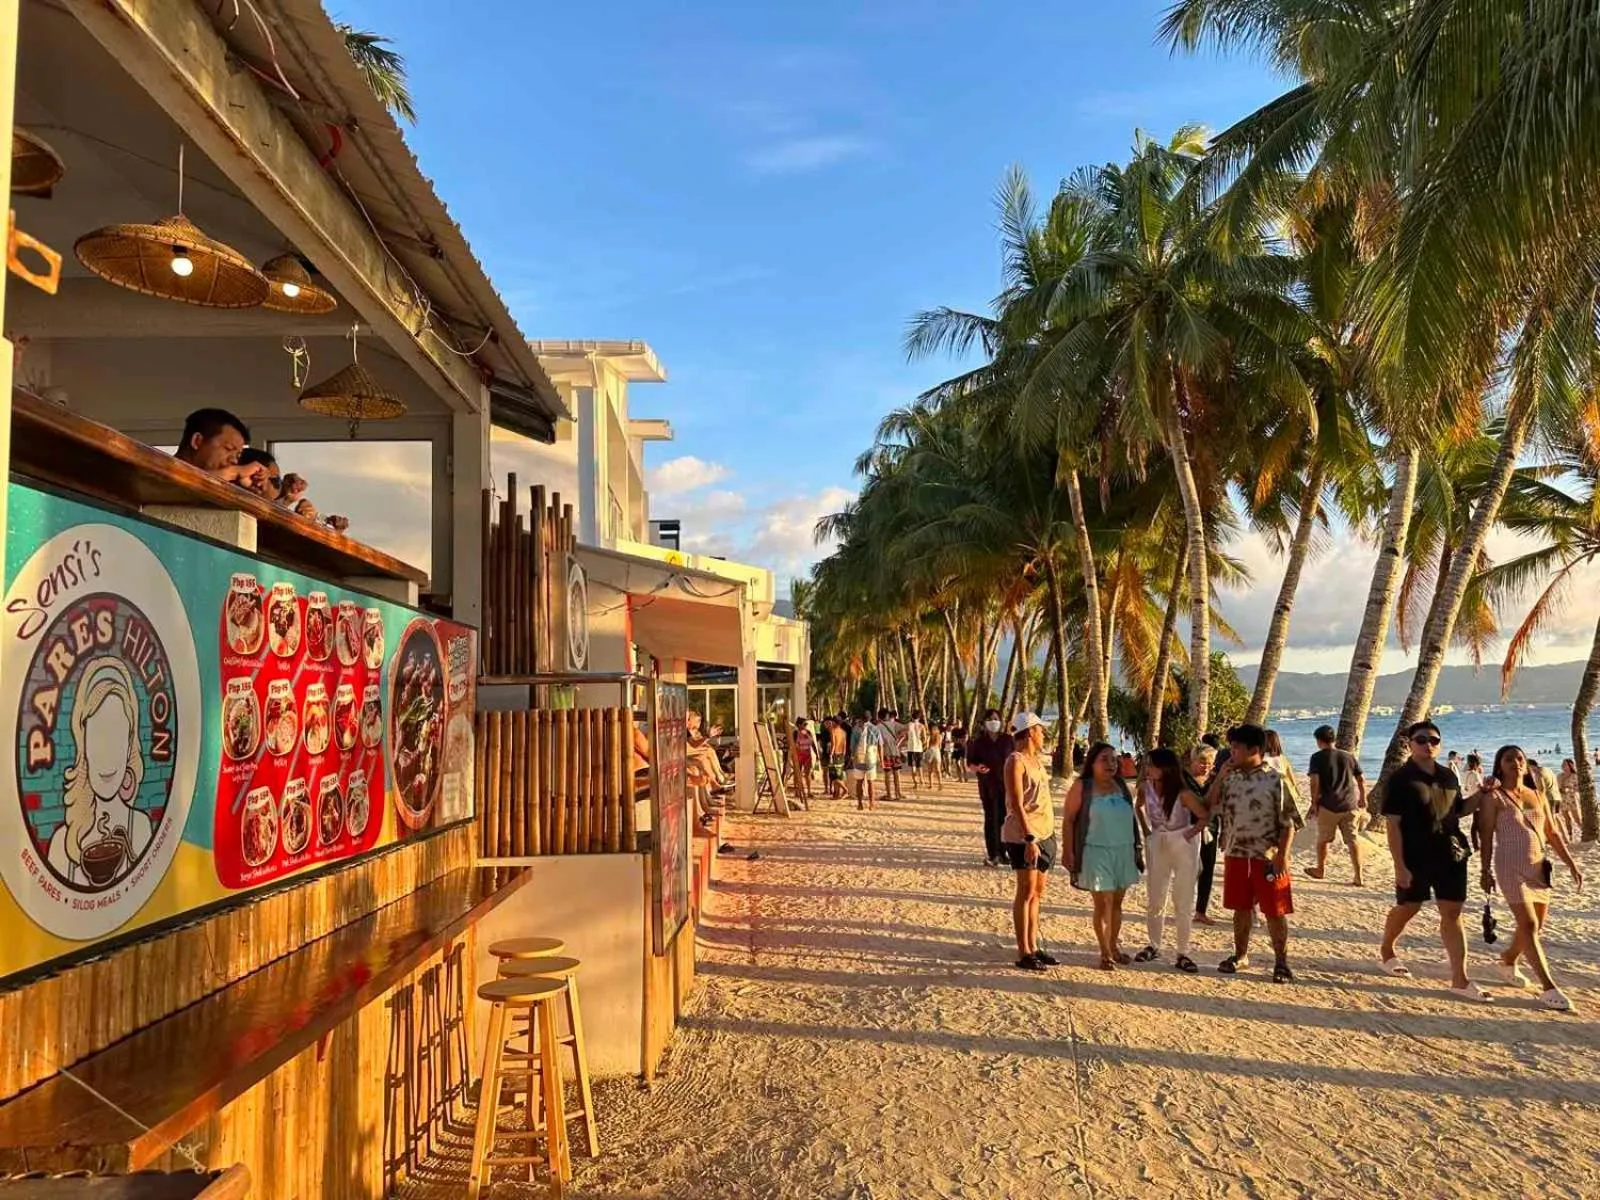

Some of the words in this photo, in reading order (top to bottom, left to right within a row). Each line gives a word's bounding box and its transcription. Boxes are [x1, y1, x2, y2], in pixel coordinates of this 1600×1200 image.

[6, 540, 101, 640] Sensi's
[232, 576, 245, 588] Php
[28, 608, 116, 771] PARES
[122, 617, 171, 757] HILTON
[228, 683, 240, 694] Php
[20, 848, 39, 875] BEEF
[38, 875, 62, 902] PARES
[131, 861, 153, 888] SHORT
[72, 898, 96, 911] SILOG
[97, 891, 122, 909] MEALS
